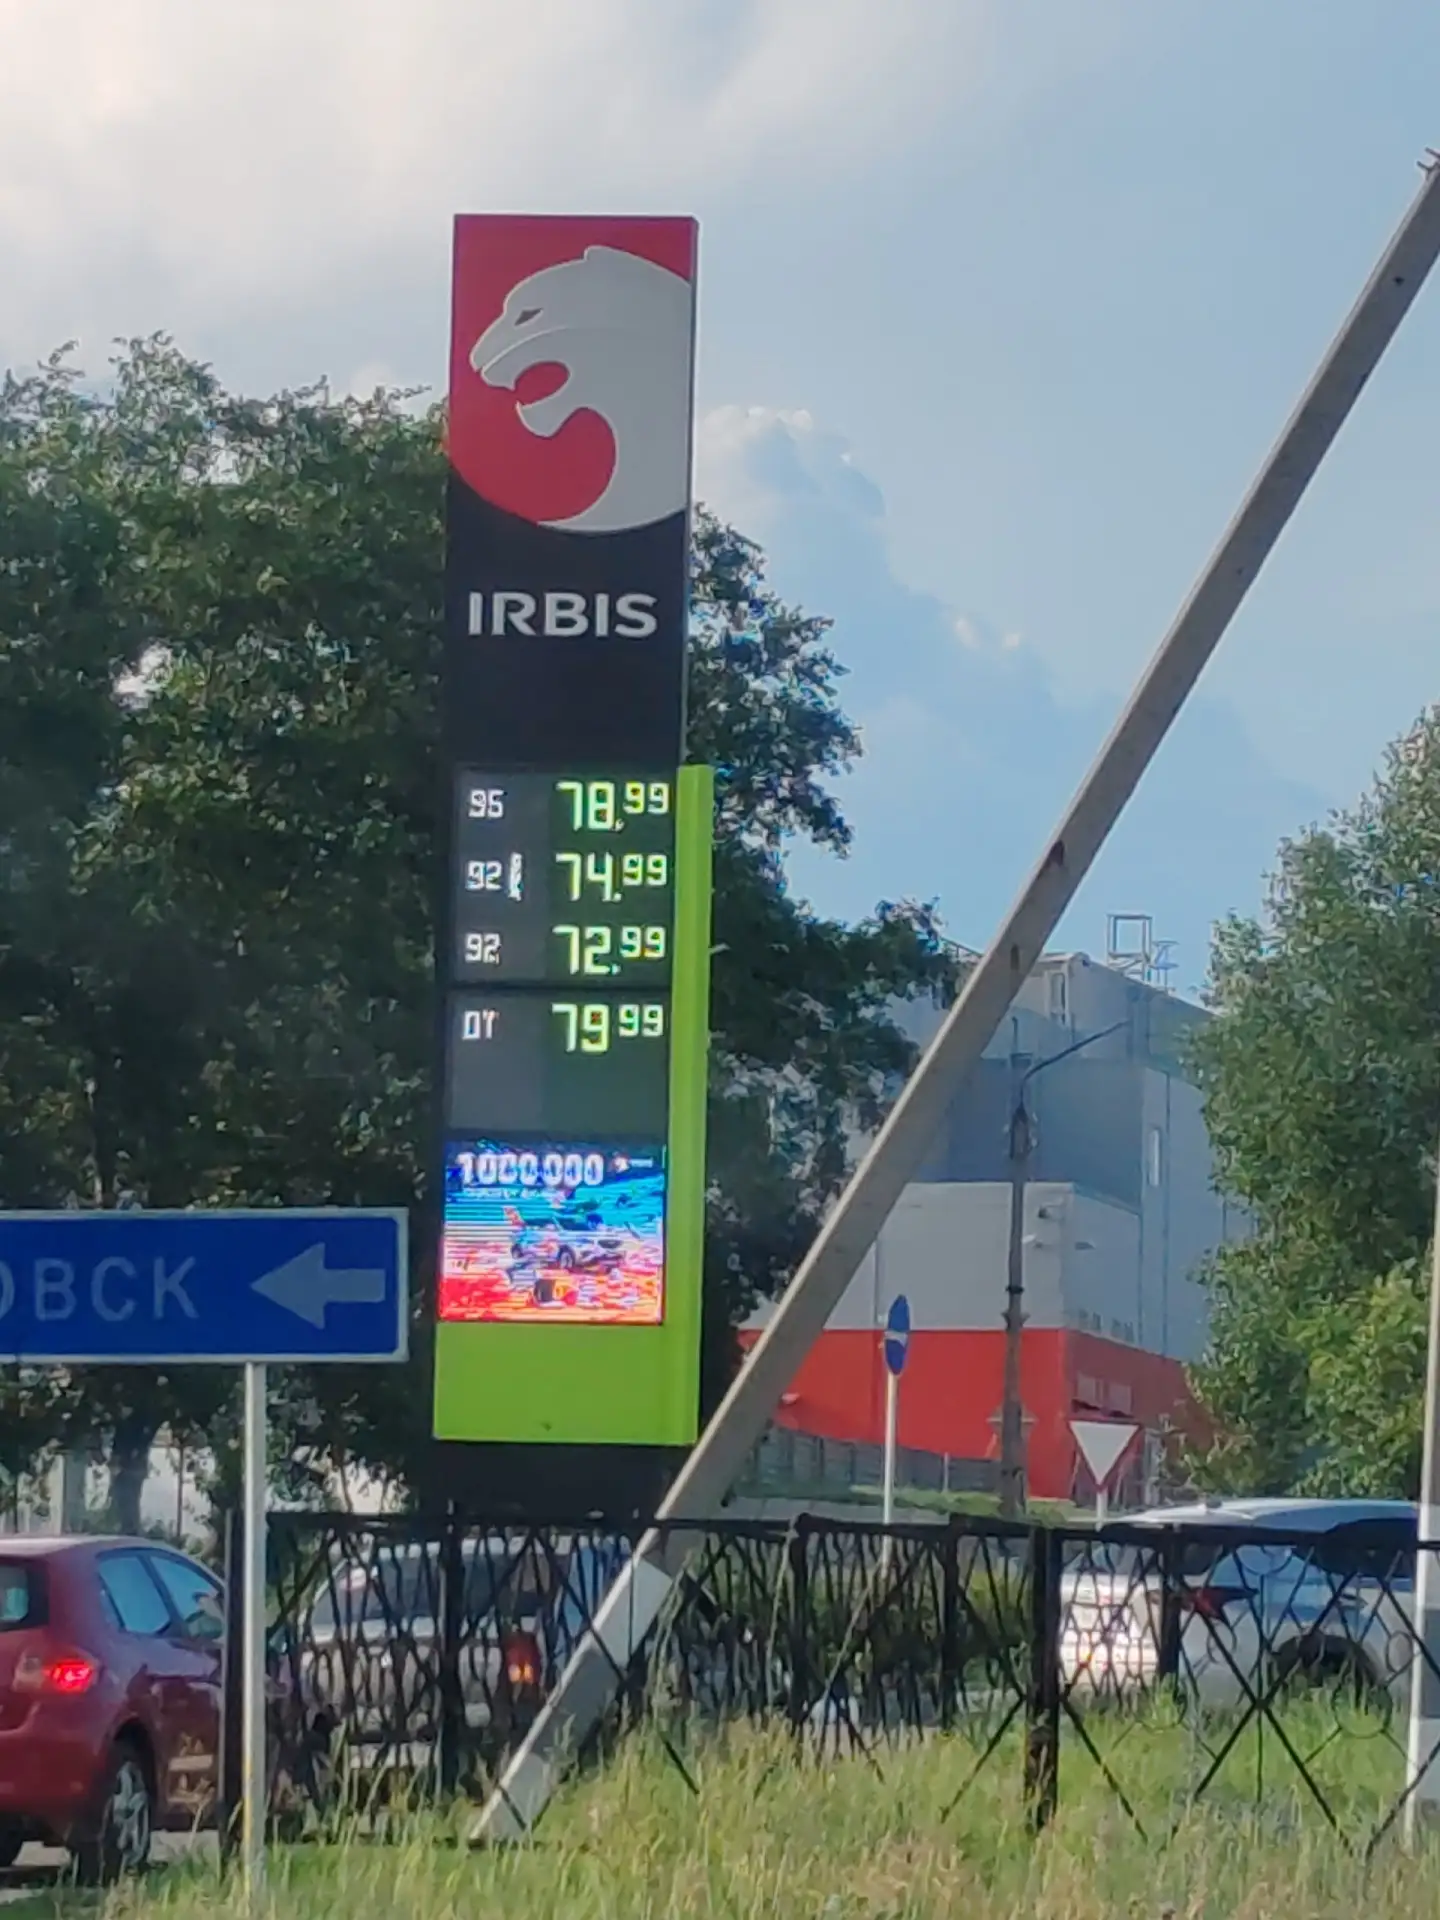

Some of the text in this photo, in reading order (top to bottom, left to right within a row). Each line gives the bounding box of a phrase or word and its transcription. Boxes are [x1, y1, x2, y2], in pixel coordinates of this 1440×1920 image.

[468, 591, 658, 637] IRBIS
[468, 789, 505, 818] 95
[466, 861, 502, 890] 92
[465, 933, 501, 964] 92
